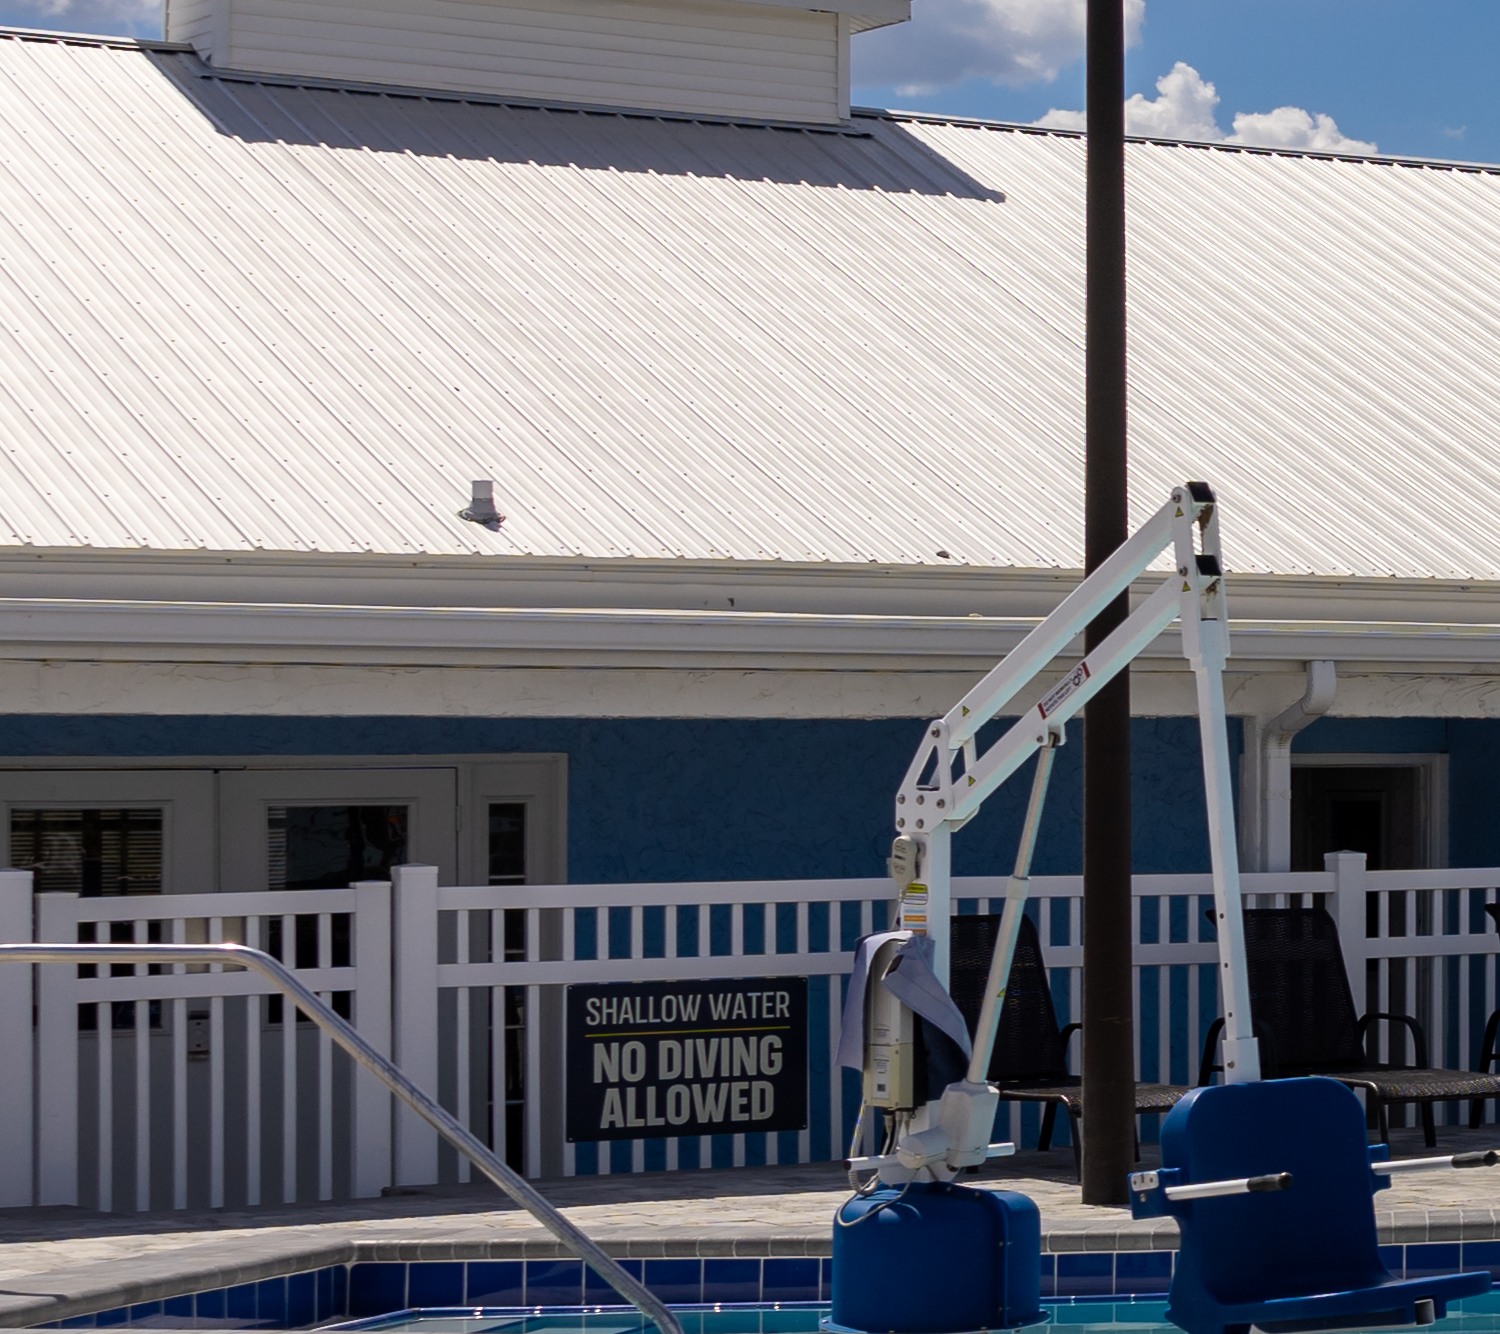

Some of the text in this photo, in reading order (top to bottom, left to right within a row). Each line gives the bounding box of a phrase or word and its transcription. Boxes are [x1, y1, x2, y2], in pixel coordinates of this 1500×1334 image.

[586, 991, 790, 1026] SHALLOW WATER
[593, 1034, 783, 1083] NO DIVING
[600, 1080, 775, 1129] ALLOWED
